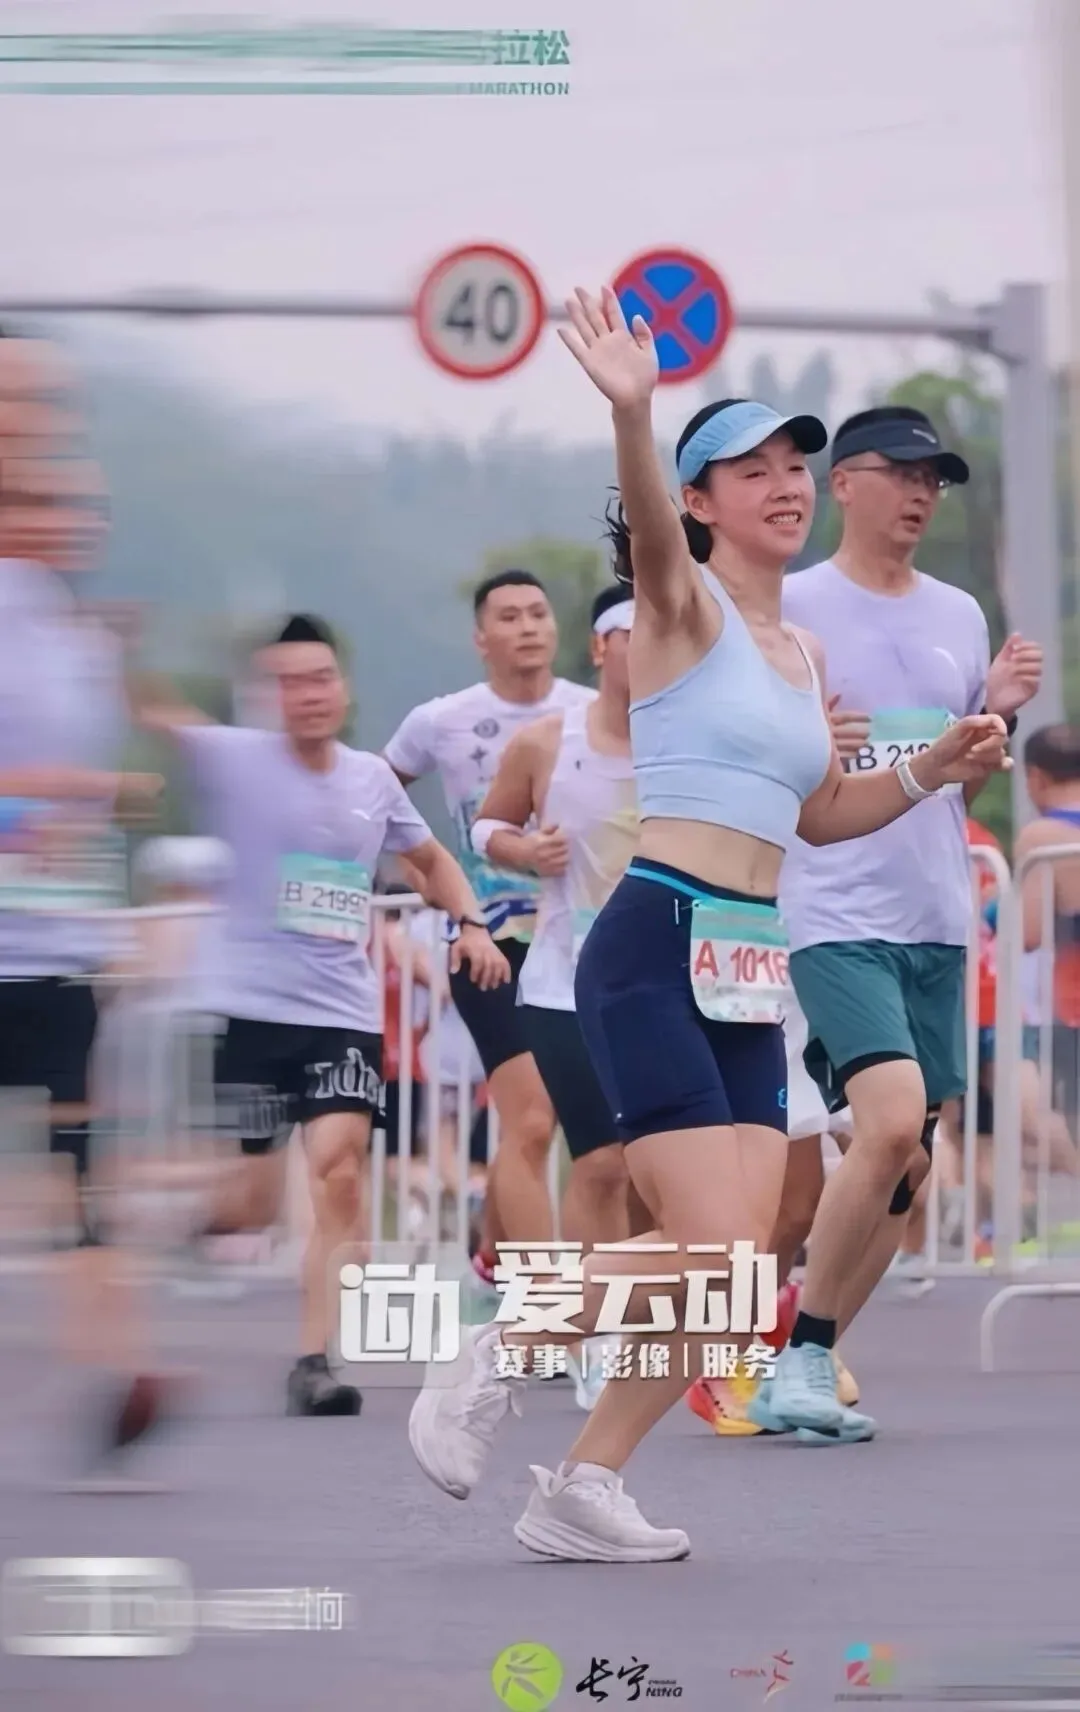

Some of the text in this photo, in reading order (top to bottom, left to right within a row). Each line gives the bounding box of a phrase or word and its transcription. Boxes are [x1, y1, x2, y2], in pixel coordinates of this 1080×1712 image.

[443, 282, 518, 344] 40
[855, 745, 877, 770] B
[285, 881, 302, 902] B
[694, 940, 719, 979] A
